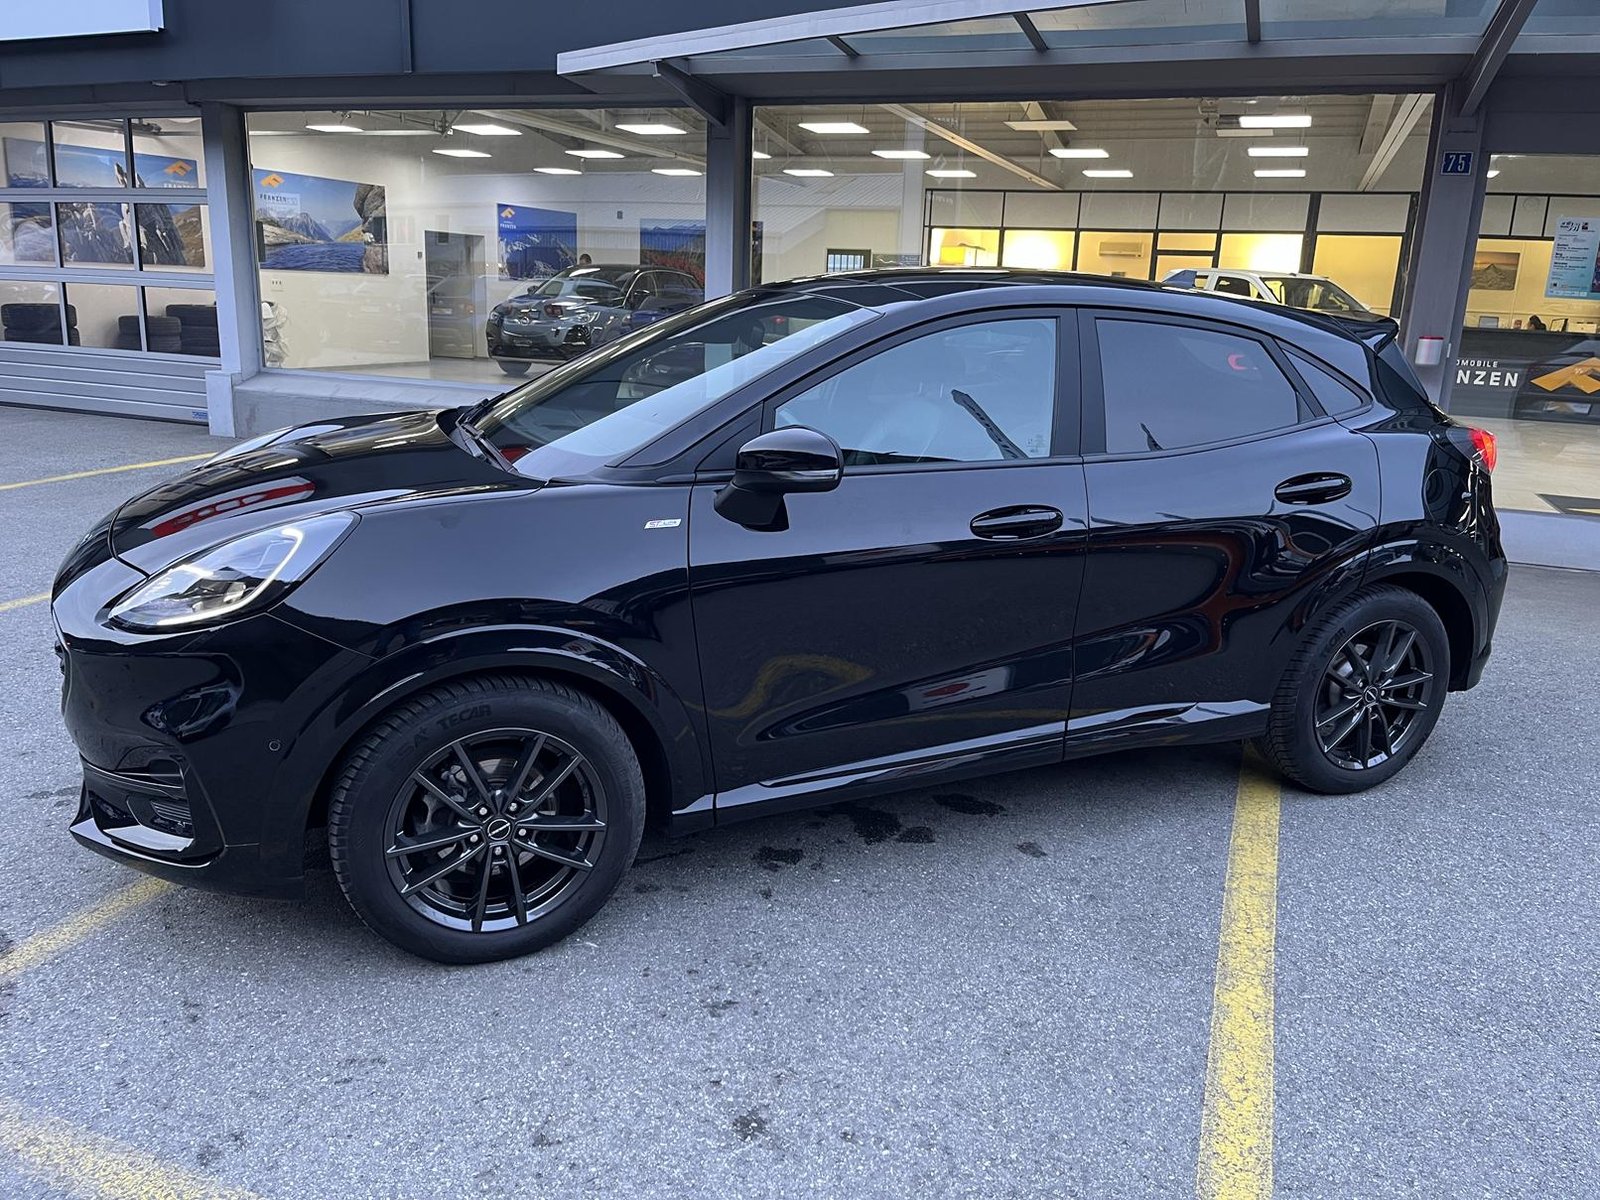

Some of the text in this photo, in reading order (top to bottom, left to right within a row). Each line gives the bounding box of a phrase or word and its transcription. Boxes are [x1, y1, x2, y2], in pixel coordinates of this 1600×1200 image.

[1447, 154, 1467, 172] 75
[259, 193, 287, 203] FRANZEN
[1456, 369, 1519, 387] NZEN
[436, 703, 492, 730] TECAR
